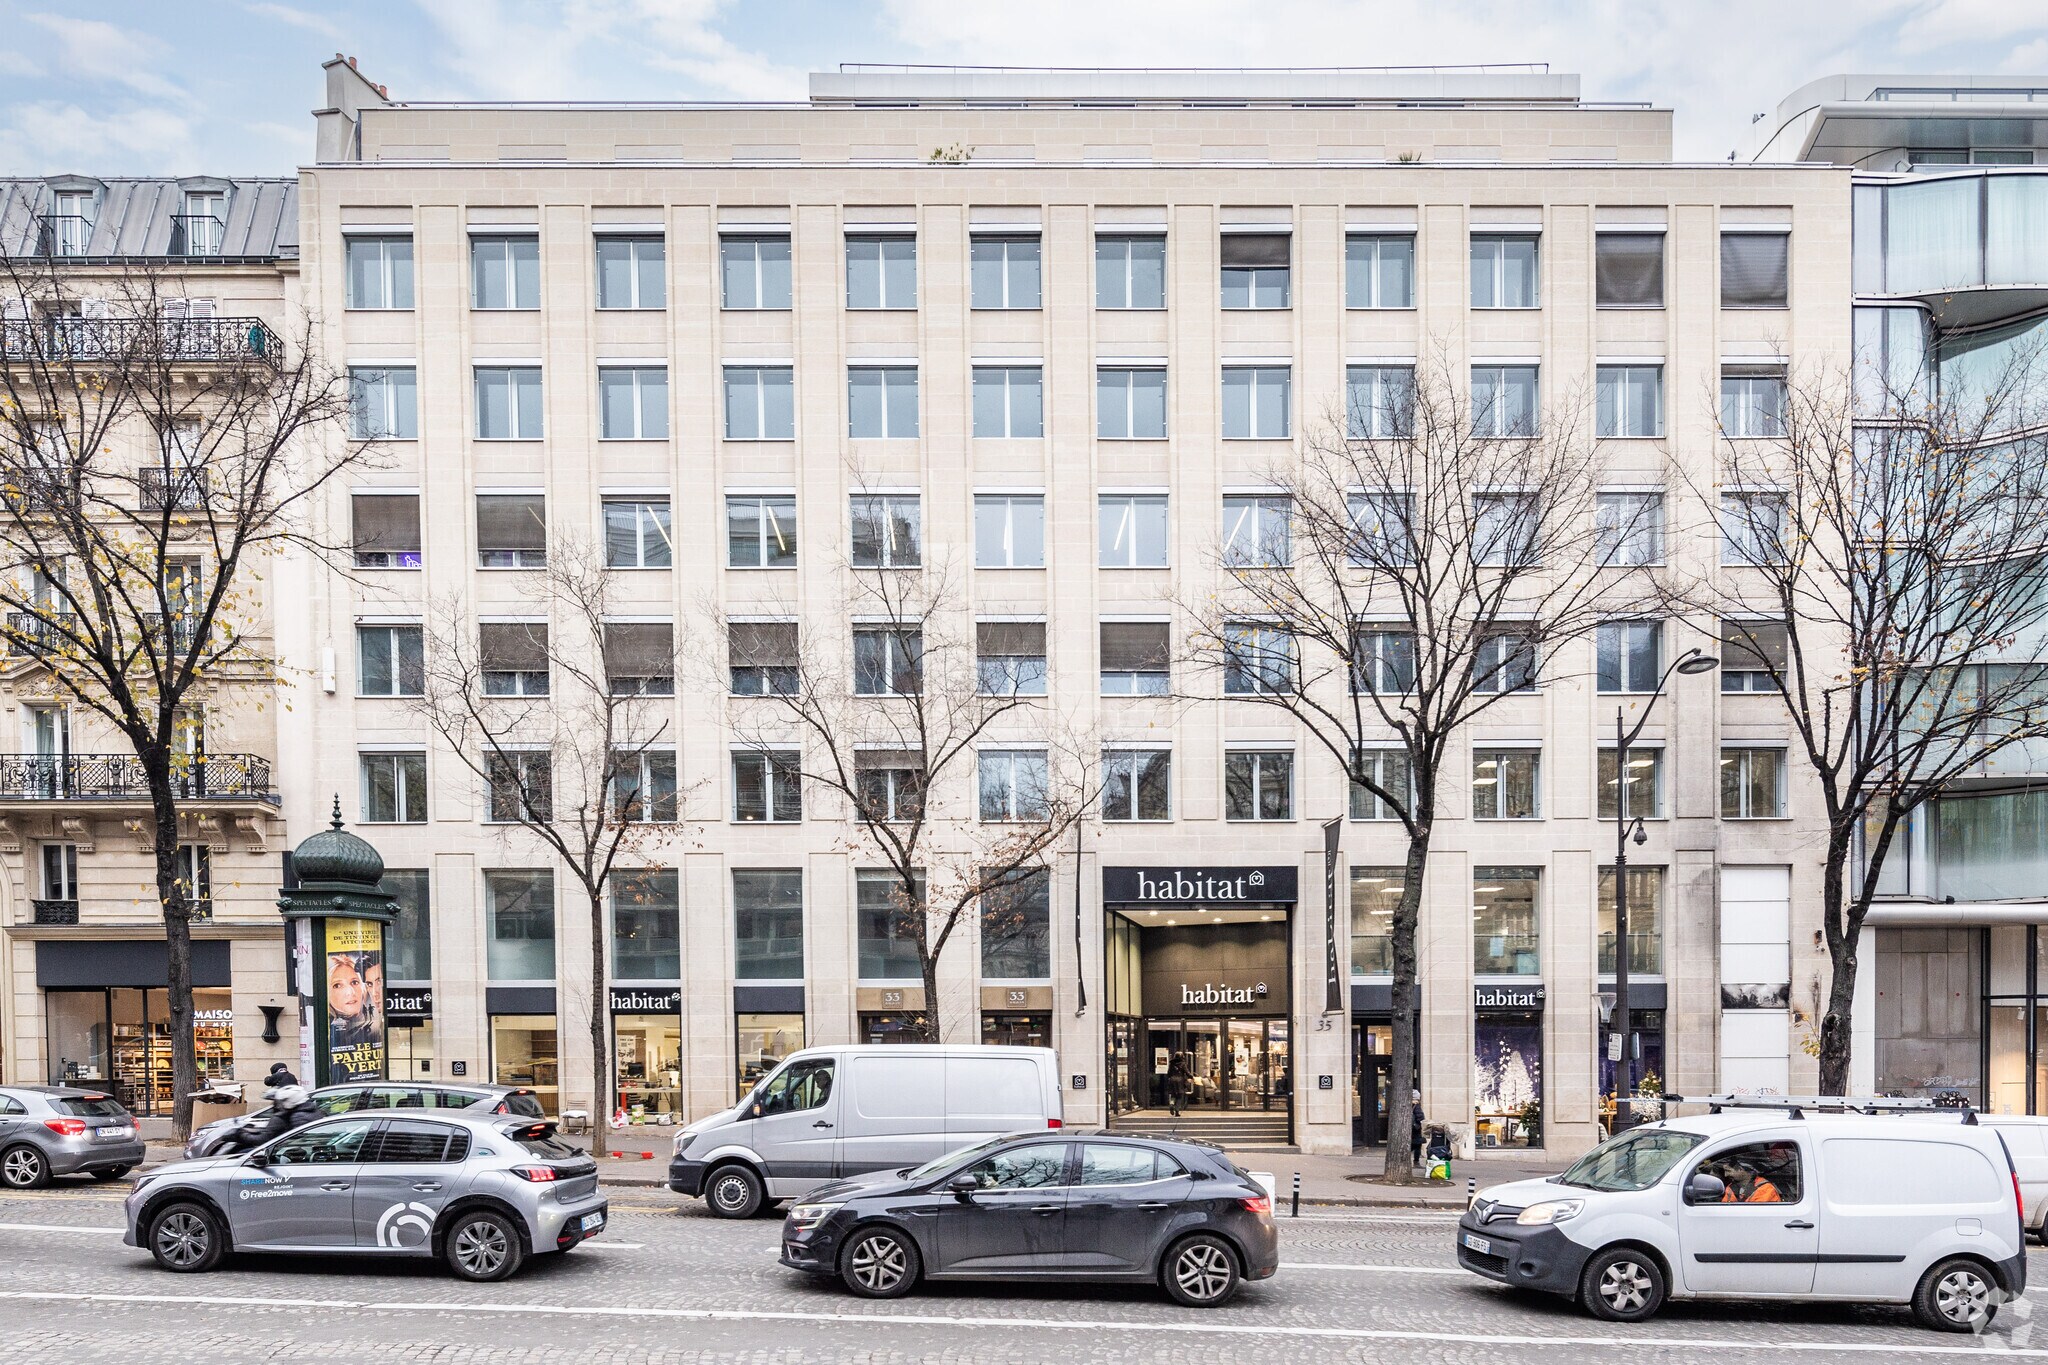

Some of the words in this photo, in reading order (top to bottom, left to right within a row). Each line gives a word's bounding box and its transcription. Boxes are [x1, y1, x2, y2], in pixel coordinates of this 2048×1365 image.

[1137, 871, 1247, 899] habitat
[348, 900, 386, 910] SPECTACLES
[885, 992, 900, 1002] 33
[1009, 991, 1025, 1001] 33
[1180, 983, 1255, 1004] habitat
[1475, 989, 1536, 1006] habitat
[386, 993, 423, 1010] bitat
[610, 992, 671, 1009] habitat
[193, 1010, 233, 1019] MAISO
[1315, 1020, 1332, 1032] 35
[356, 1042, 371, 1051] LE
[345, 1060, 382, 1073] VERT
[250, 1190, 293, 1198] Free2move
